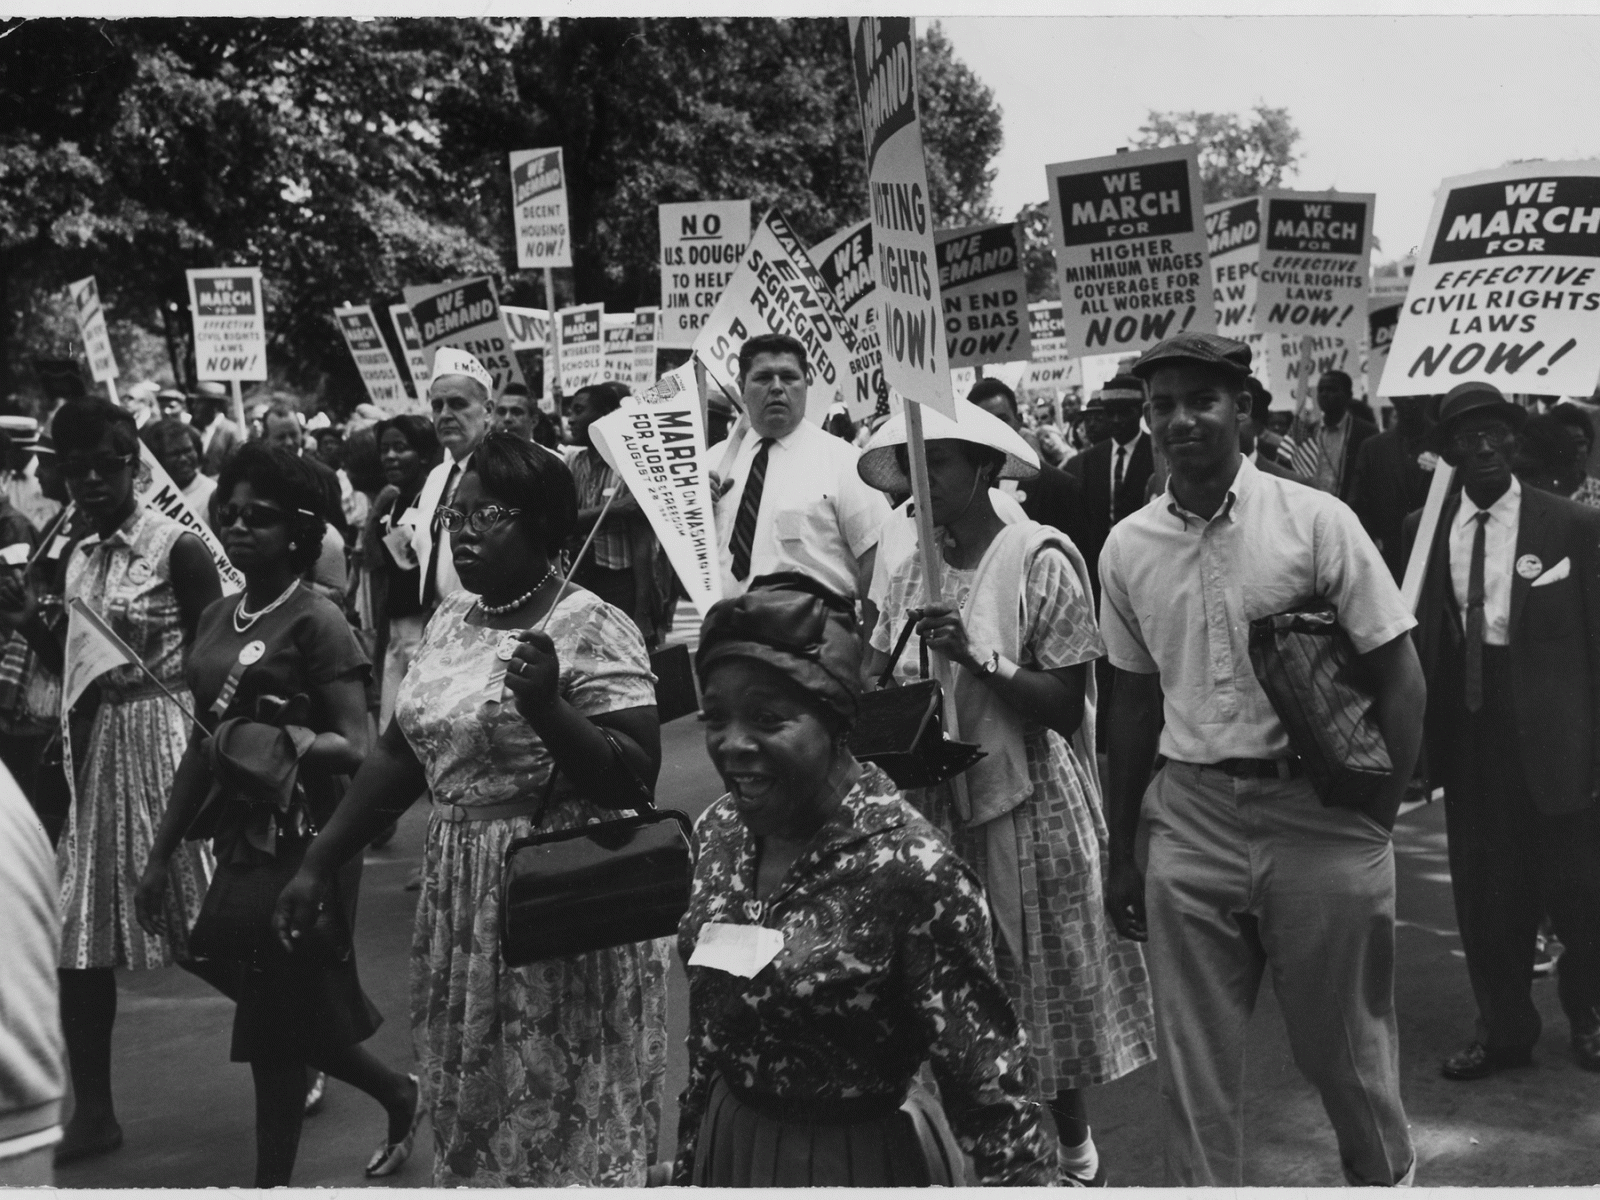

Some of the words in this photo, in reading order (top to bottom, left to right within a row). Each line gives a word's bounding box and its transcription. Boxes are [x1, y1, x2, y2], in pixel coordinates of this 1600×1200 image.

[527, 157, 546, 178] WE
[518, 168, 560, 201] DEMAND
[1102, 171, 1141, 194] WE
[1504, 182, 1557, 206] WE
[523, 204, 560, 218] DECENT
[1071, 190, 1181, 226] MARCH
[1303, 203, 1332, 219] WE
[521, 223, 566, 237] HOUSING
[681, 213, 721, 236] NO
[1107, 221, 1150, 236] FOR
[1274, 219, 1358, 241] MARCH
[1446, 206, 1600, 242] MARCH
[525, 239, 564, 257] NOW!
[770, 219, 811, 269] UAW
[1208, 220, 1257, 253] MAND
[1298, 240, 1331, 251] FOR
[1486, 238, 1546, 255] FOR
[689, 243, 745, 266] DOUGH
[834, 234, 863, 277] WE
[944, 235, 981, 262] WE
[1090, 239, 1174, 263] HIGHER
[938, 246, 1014, 286] EMAND
[1065, 260, 1142, 283] MINIMUM
[1147, 252, 1203, 273] WAGES
[1273, 256, 1357, 273] EFFECTIVE
[213, 279, 233, 291] WE
[672, 273, 690, 288] TO
[834, 254, 874, 314] EMA
[1074, 276, 1160, 300] COVERAGE
[1166, 272, 1200, 289] FOR
[1260, 270, 1301, 285] CIVIL
[1304, 272, 1362, 289] RIGHTS
[1435, 265, 1596, 290] EFFECTIVE
[199, 291, 252, 306] MARCH
[436, 289, 465, 314] WE
[667, 293, 689, 308] JIM
[695, 292, 722, 308] CRO
[771, 259, 833, 343] END
[943, 296, 962, 313] N
[969, 289, 1018, 311] END
[1081, 299, 1109, 315] ALL
[1113, 288, 1196, 311] WORKERS
[1213, 284, 1246, 303] AW
[1286, 287, 1332, 302] LAWS
[1409, 293, 1478, 315] CIVIL
[1485, 290, 1600, 311] RIGHTS
[424, 298, 494, 340] DEMAND
[679, 314, 710, 330] GRO
[747, 249, 836, 385] SEGREGATED
[849, 313, 859, 330] N
[945, 317, 962, 333] O
[966, 309, 1019, 331] BIAS
[1085, 305, 1197, 348] NOW!
[1215, 304, 1257, 327] OW!
[1268, 302, 1354, 328] NOW!
[1449, 314, 1537, 335] LAWS
[563, 320, 598, 337] MARCH
[885, 301, 937, 375] NOW!
[214, 344, 244, 352] LAWS
[464, 338, 504, 355] END
[856, 331, 881, 355] OLI
[1281, 337, 1345, 358] RIHTS
[206, 355, 258, 372] NOW!
[562, 359, 600, 372] SCHOOLS
[604, 359, 614, 370] N
[616, 360, 632, 371] EN
[849, 349, 882, 375] BRUTA
[1407, 337, 1577, 378] NOW!
[566, 371, 599, 389] NOW!
[603, 371, 613, 380] O
[614, 371, 632, 382] BIA
[856, 367, 884, 403] NO
[1030, 366, 1073, 382] NOW!
[653, 410, 700, 488] MARCH
[621, 434, 652, 483] AUGUST
[647, 487, 659, 500] 28
[628, 413, 655, 440] FOR
[642, 444, 669, 485] JOBS
[660, 491, 686, 537] FREEDOM
[681, 490, 697, 508] ON
[151, 484, 211, 542] MAR
[683, 507, 712, 592] WASHINGTON
